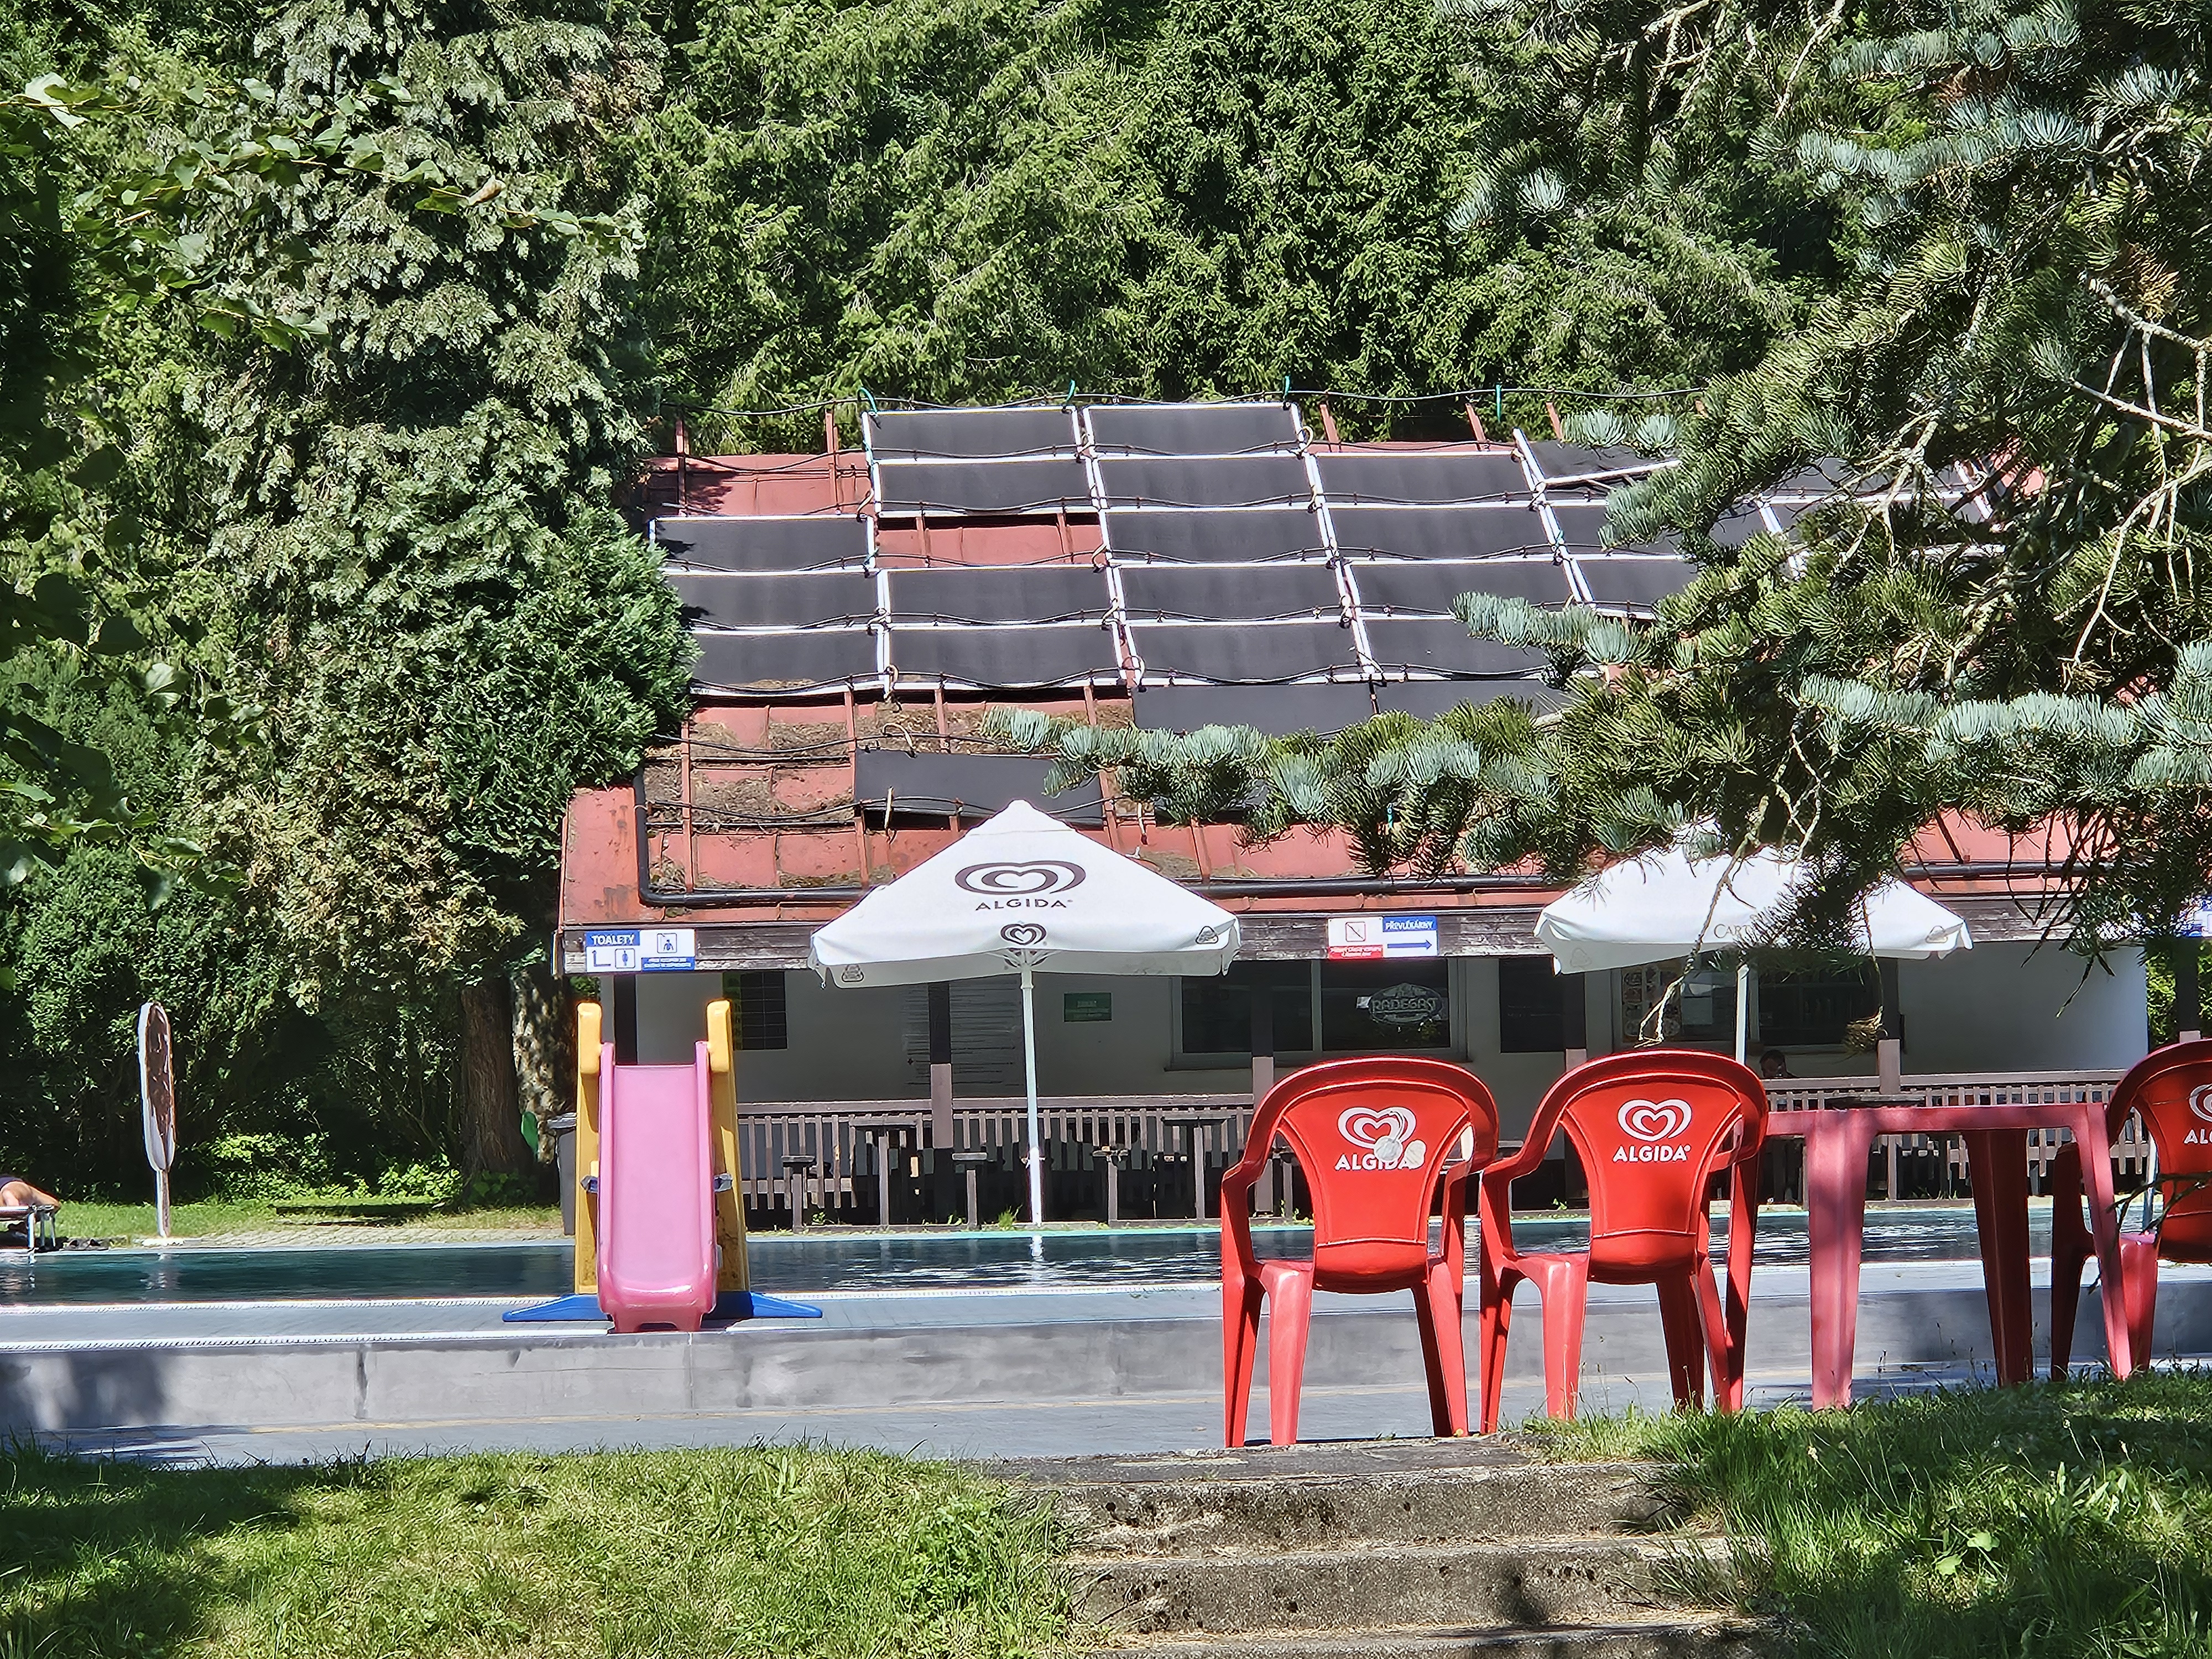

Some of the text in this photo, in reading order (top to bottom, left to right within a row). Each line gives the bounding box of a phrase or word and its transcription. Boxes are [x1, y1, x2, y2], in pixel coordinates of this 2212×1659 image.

[975, 899, 1067, 911] ALGIDA
[591, 934, 634, 945] TOALETY
[2183, 1129, 2212, 1144] AL
[1613, 1145, 1687, 1162] ALGIDA
